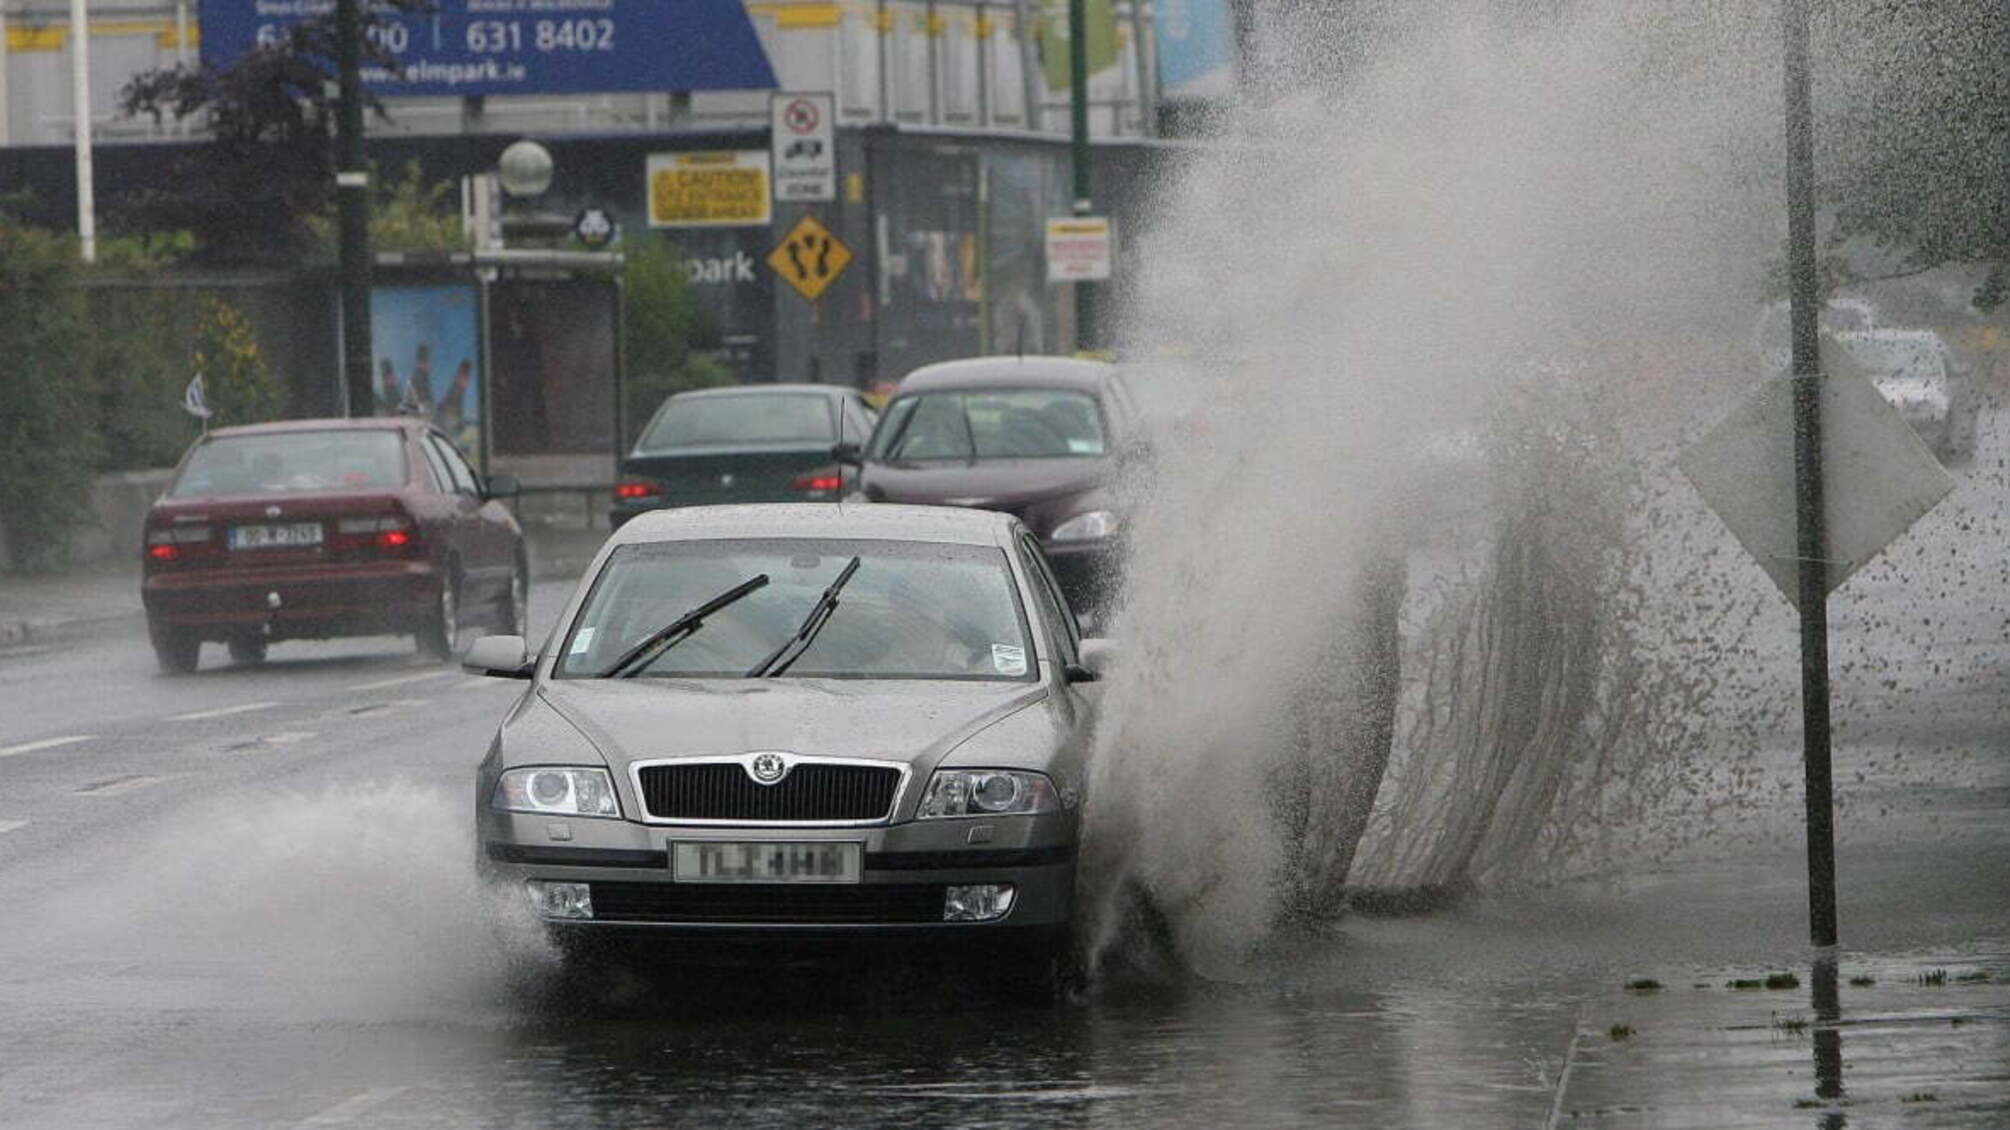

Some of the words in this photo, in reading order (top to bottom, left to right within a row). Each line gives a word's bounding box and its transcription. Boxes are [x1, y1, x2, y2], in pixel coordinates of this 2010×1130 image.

[466, 20, 521, 52] 631
[535, 18, 615, 51] 8402
[358, 59, 527, 85] wwelmpark.ie
